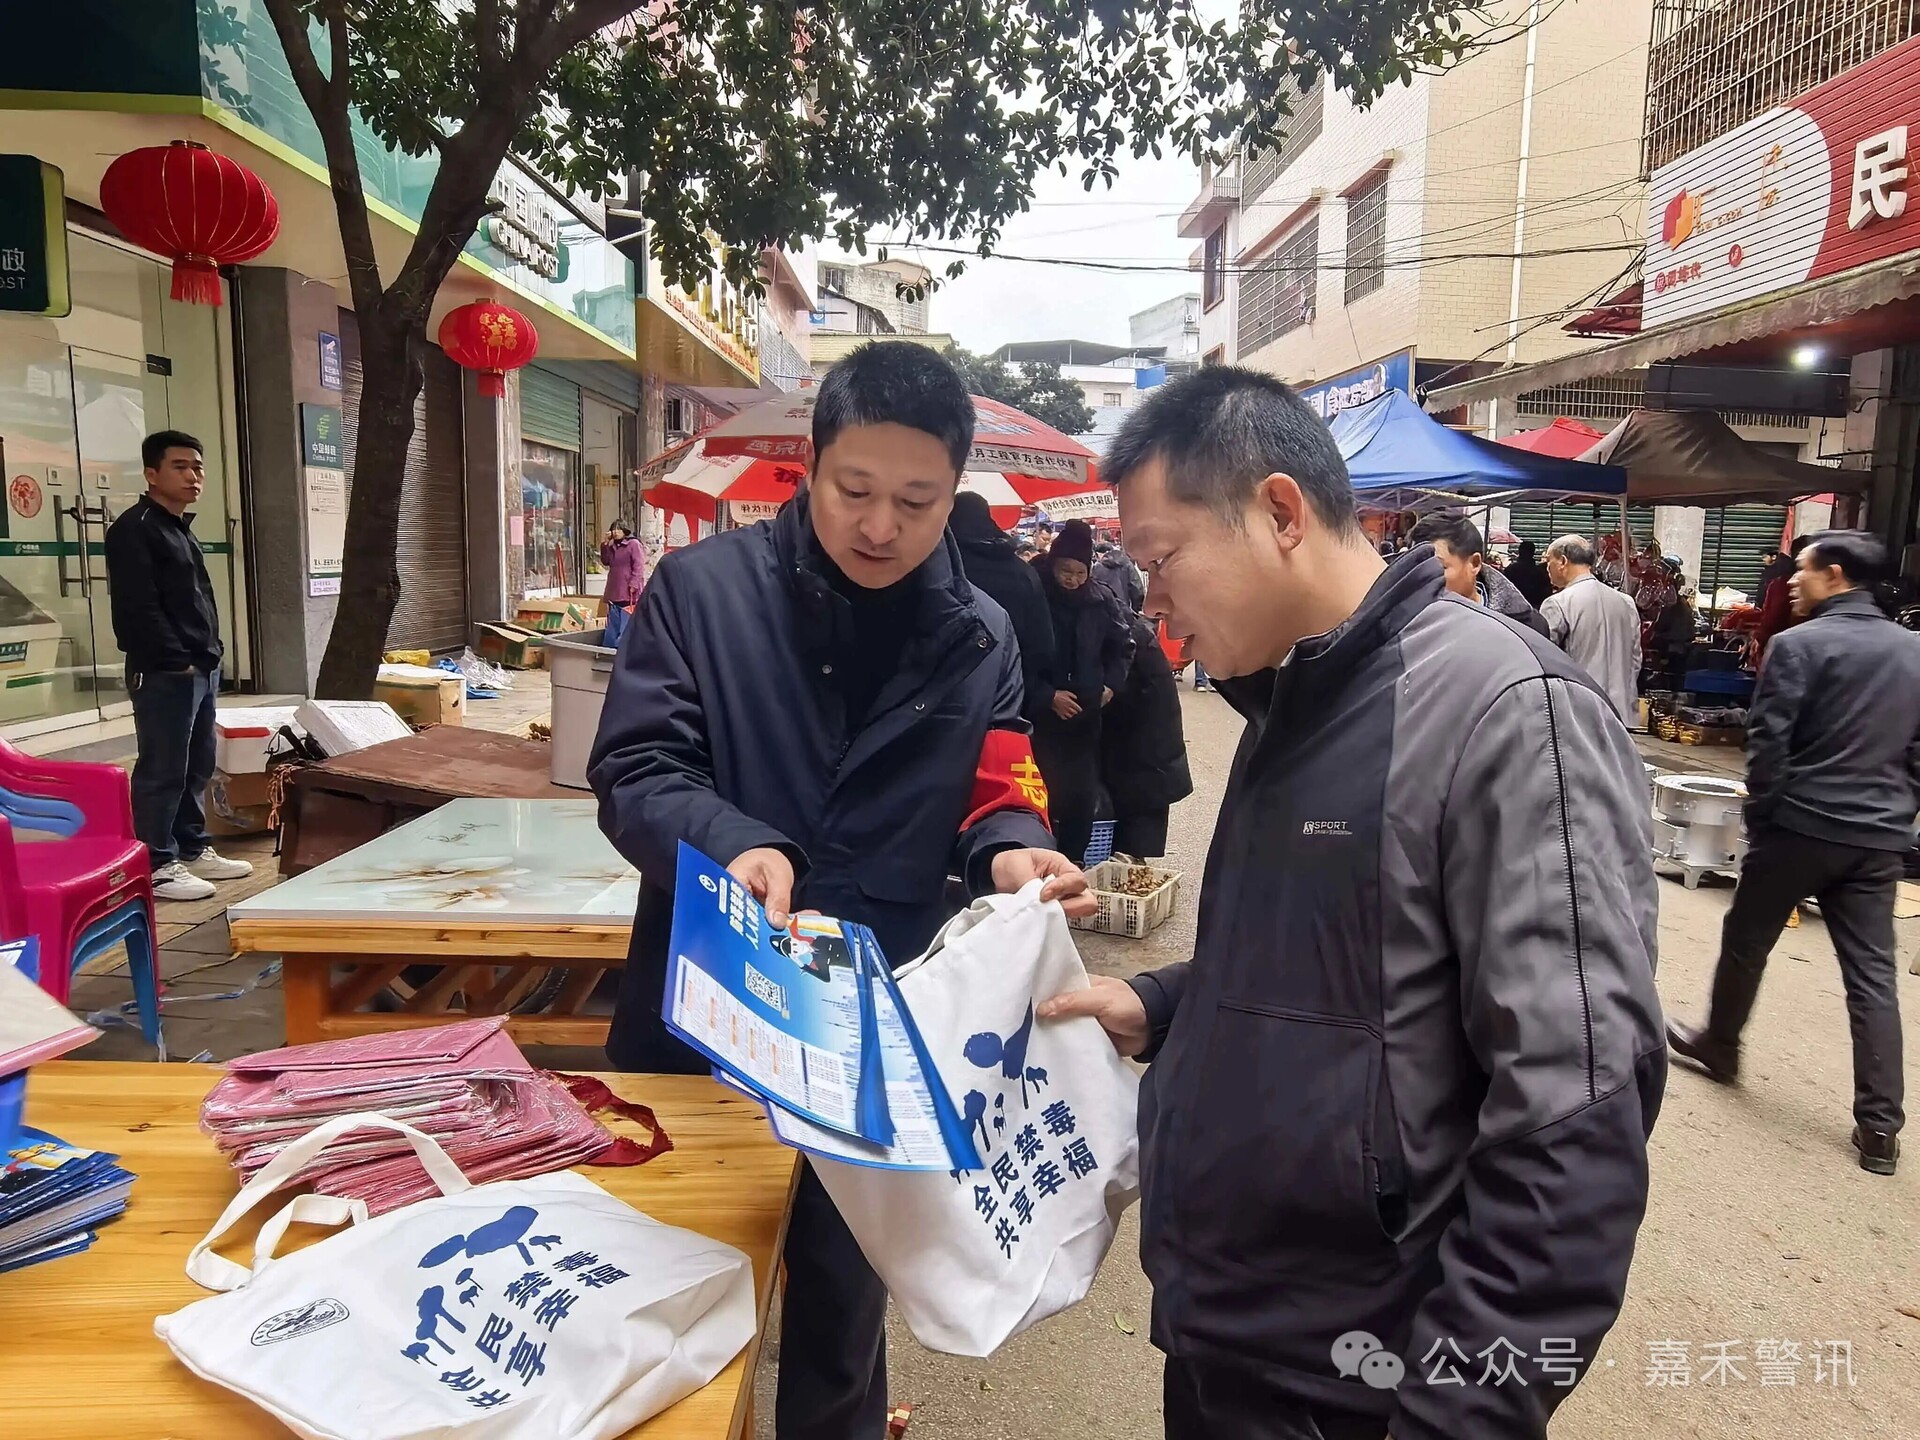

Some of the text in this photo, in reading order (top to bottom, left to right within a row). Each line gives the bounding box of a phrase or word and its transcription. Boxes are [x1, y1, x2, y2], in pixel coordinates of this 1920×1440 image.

[1848, 125, 1909, 231] 民
[2, 247, 26, 272] 政
[968, 447, 1077, 471] 月工程官方合作伙伴
[1010, 755, 1049, 809] 志
[1314, 821, 1349, 830] SPORT
[974, 1100, 1077, 1224] 全民禁毒
[995, 1136, 1099, 1259] 共享幸福
